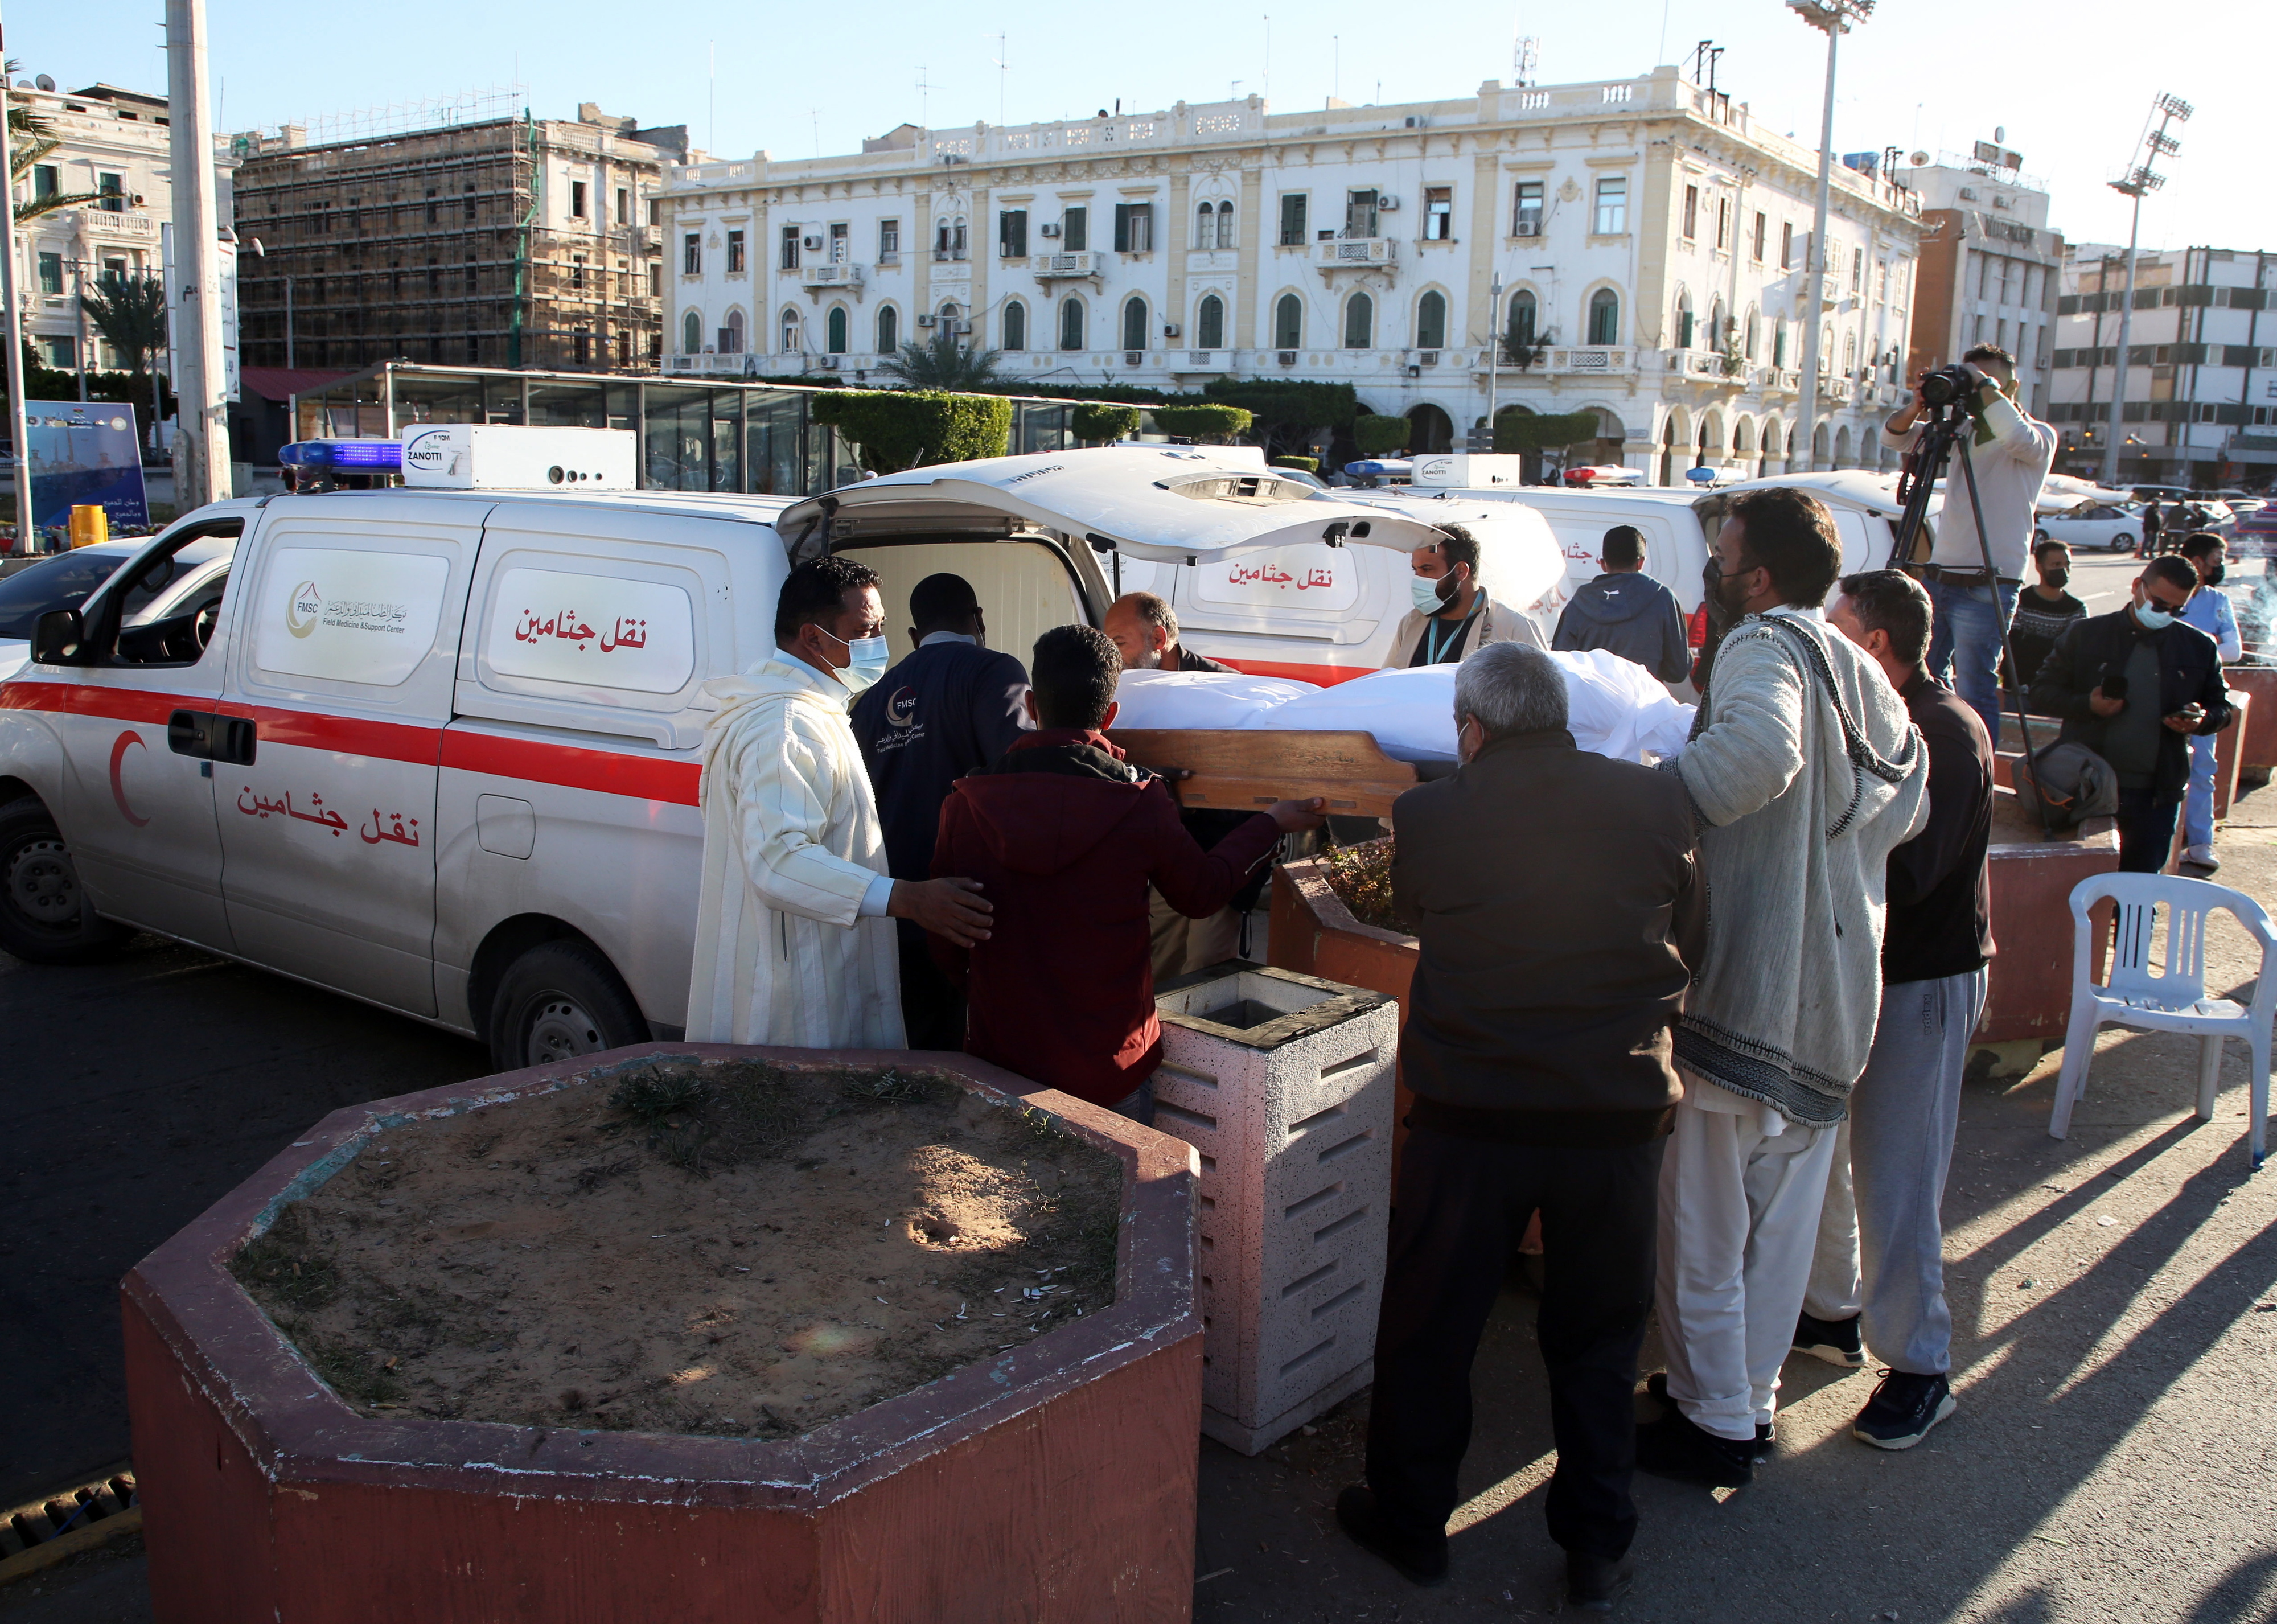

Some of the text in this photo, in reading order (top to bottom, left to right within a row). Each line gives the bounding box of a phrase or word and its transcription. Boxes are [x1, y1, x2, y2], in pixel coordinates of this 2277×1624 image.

[408, 451, 442, 461] ZANOTTI
[1229, 563, 1332, 590] نقل جثامين
[297, 602, 318, 614] FMSC
[323, 618, 335, 626] Field
[336, 619, 359, 629] Medicine
[387, 624, 405, 634] Center
[515, 609, 646, 652] نقل جثامين
[237, 786, 419, 847] نقل جثامين
[1922, 994, 1932, 1035] Kappa
